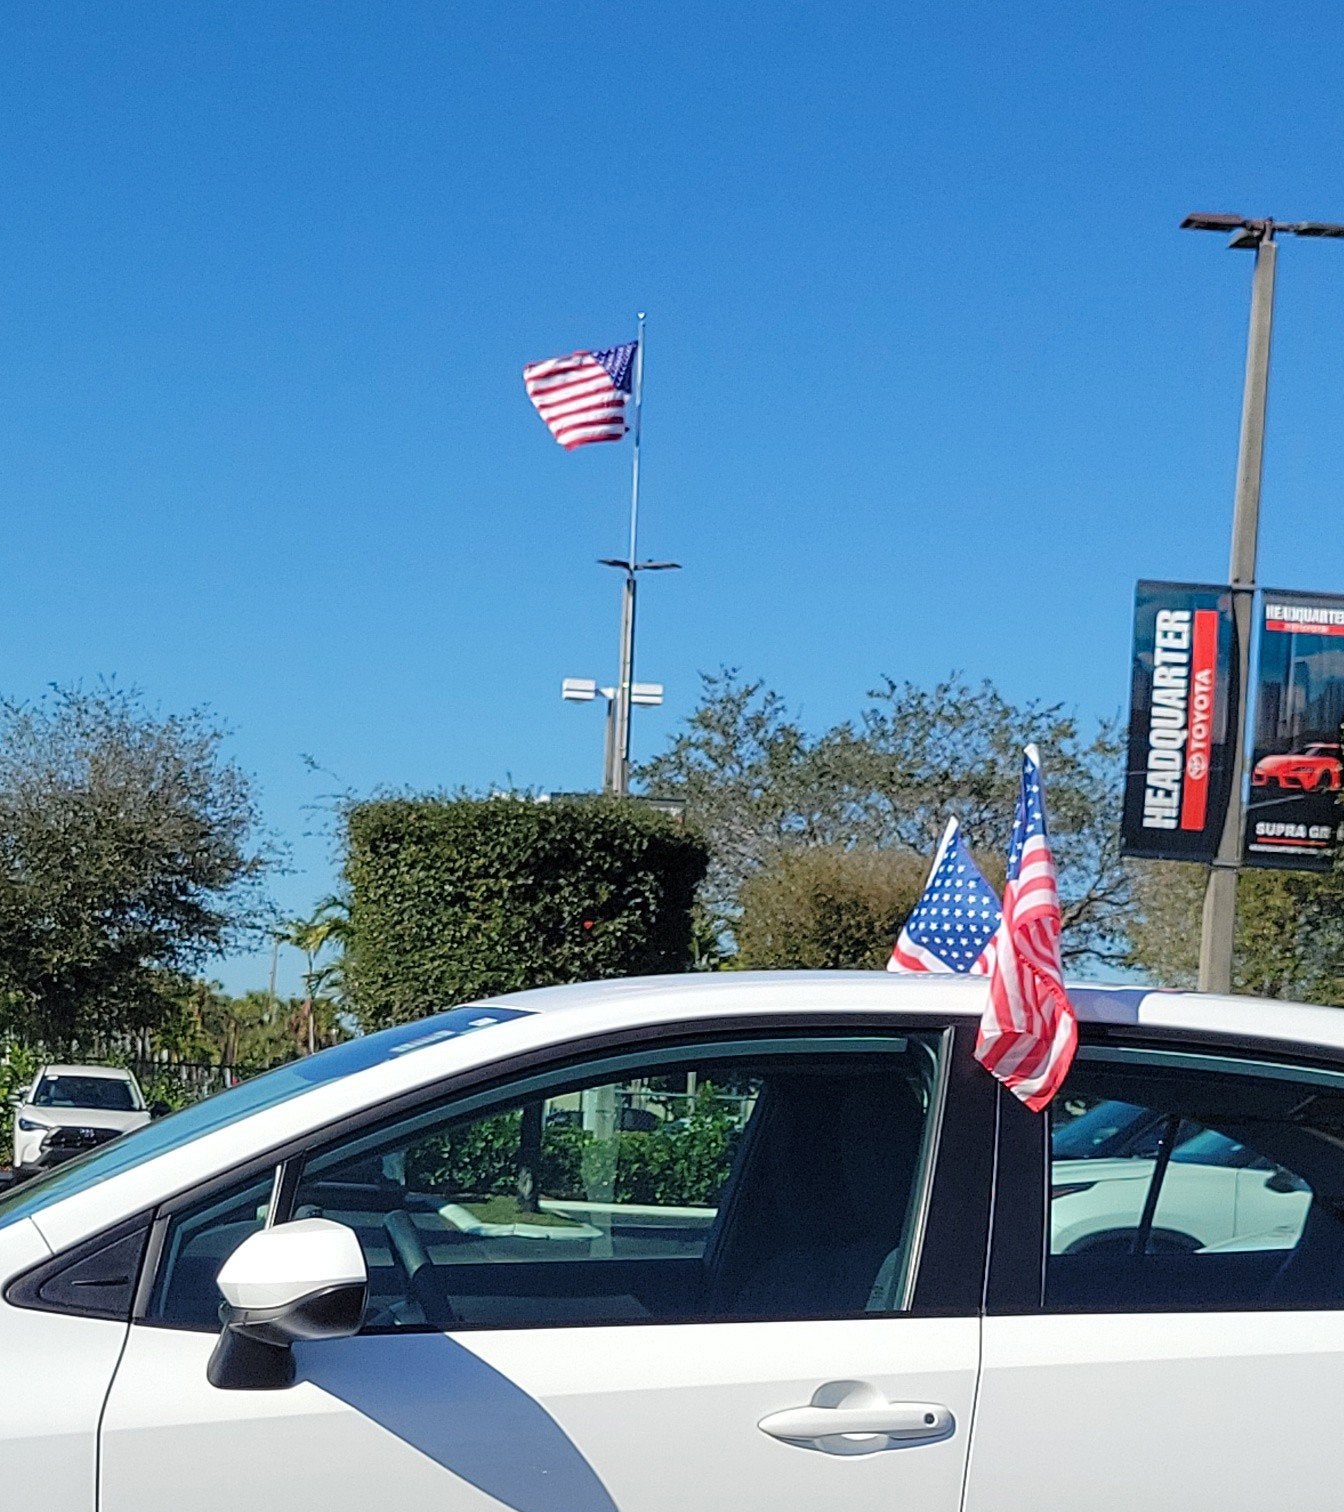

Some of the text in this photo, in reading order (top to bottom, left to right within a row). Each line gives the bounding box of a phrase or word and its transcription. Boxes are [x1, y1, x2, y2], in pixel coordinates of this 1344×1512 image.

[1142, 609, 1192, 829] HEADQUARTER
[1190, 668, 1213, 752] TOYOTA
[1255, 821, 1307, 838] SUPRA
